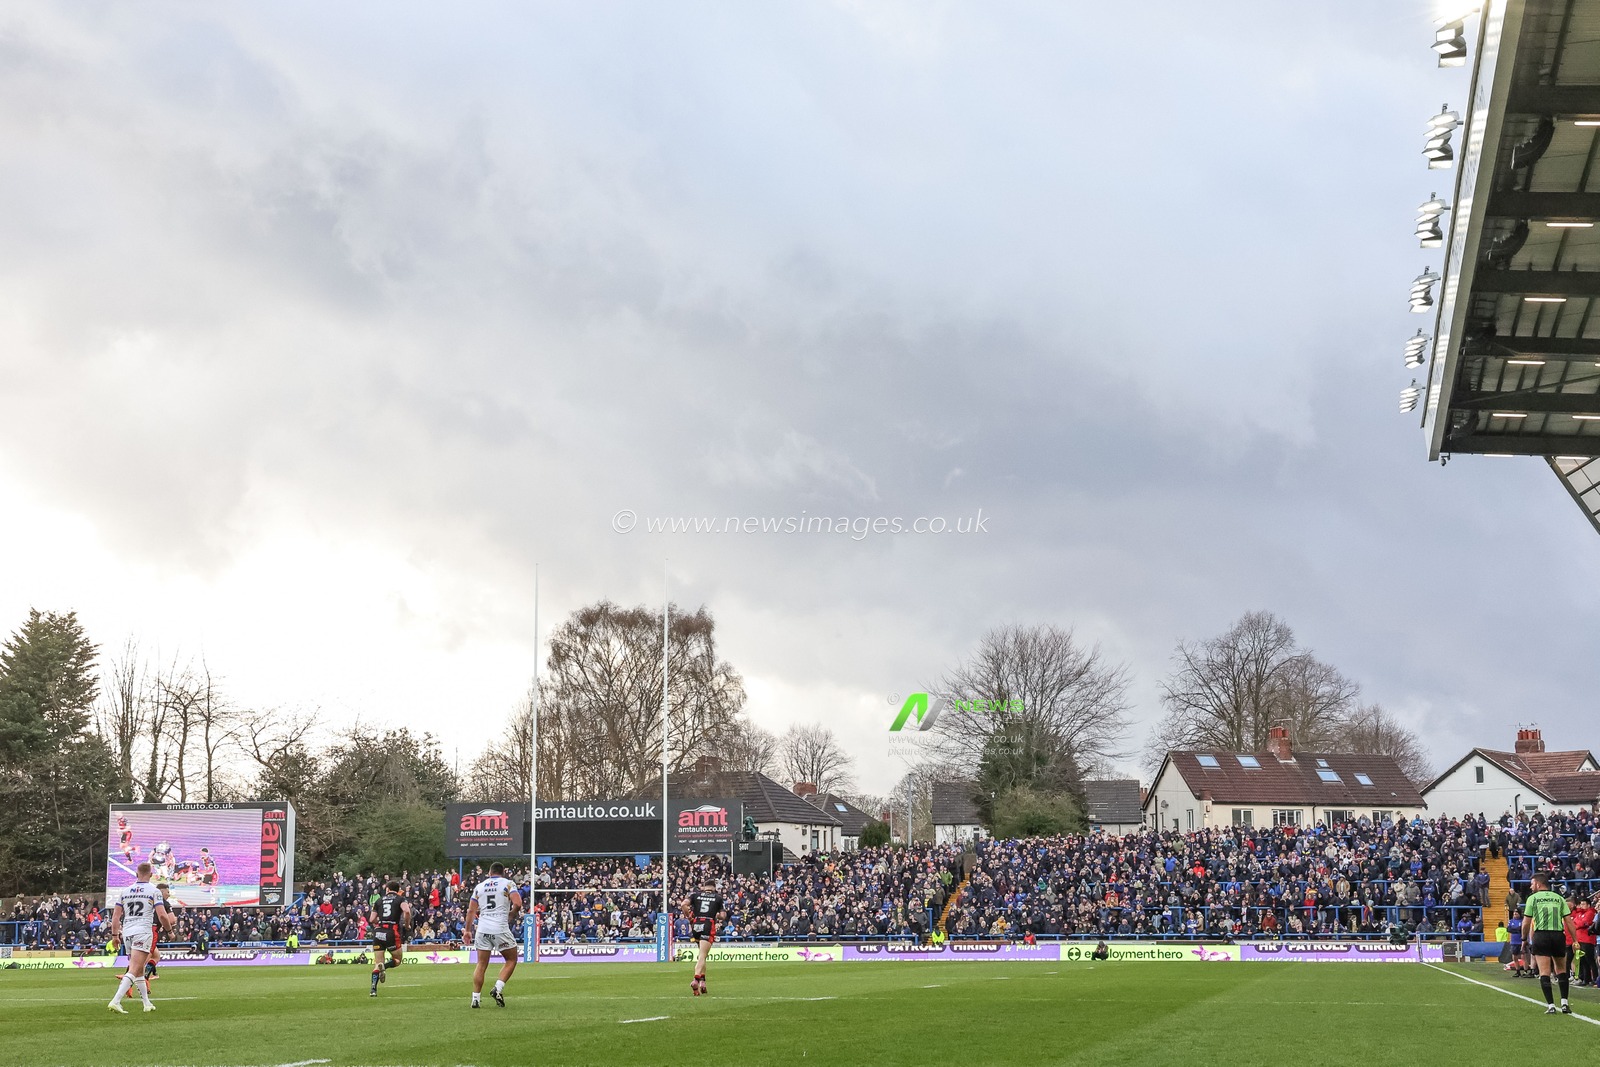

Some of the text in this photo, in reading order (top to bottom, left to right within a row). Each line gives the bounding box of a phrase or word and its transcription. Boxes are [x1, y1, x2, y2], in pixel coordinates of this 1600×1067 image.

[167, 802, 234, 810] amtauto.co.uk
[534, 802, 656, 819] amtauto.co.uk
[263, 810, 286, 819] amt
[460, 811, 509, 830] amt
[678, 807, 728, 827] amt
[260, 822, 282, 887] amt
[127, 901, 144, 916] 12
[486, 895, 497, 910] 5
[700, 901, 711, 913] 5
[382, 903, 392, 918] 3
[697, 951, 789, 962] mployment hero
[1084, 949, 1183, 961] eloyment hero
[43, 961, 65, 969] hero
